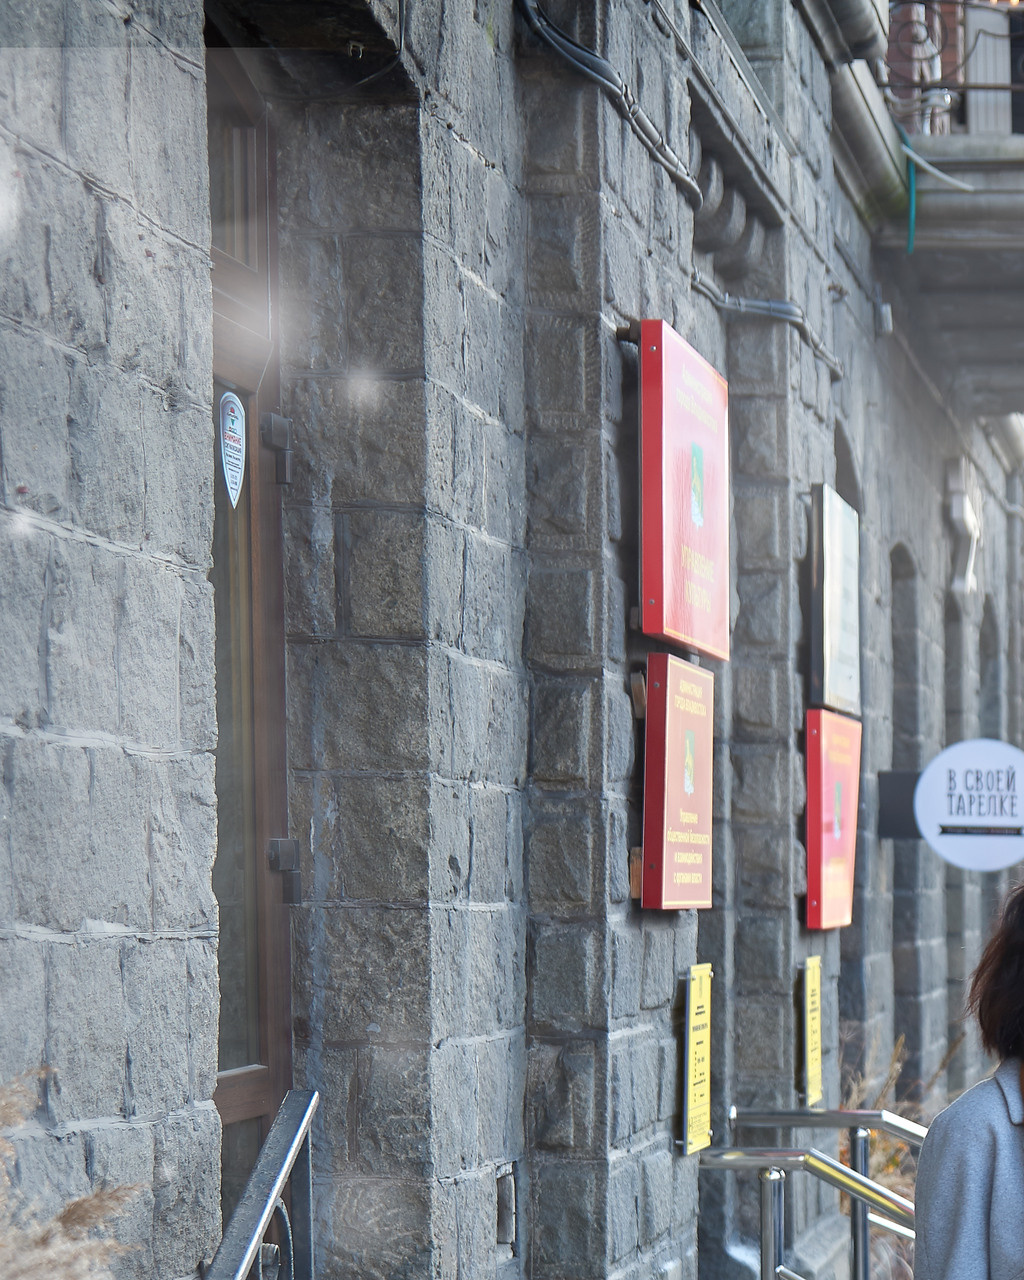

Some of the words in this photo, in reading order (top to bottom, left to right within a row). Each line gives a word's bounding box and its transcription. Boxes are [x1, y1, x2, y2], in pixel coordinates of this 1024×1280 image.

[947, 768, 957, 792] В
[964, 764, 1017, 793] СВОЕЙ
[946, 793, 1019, 818] ТАРЕЛКЕ
